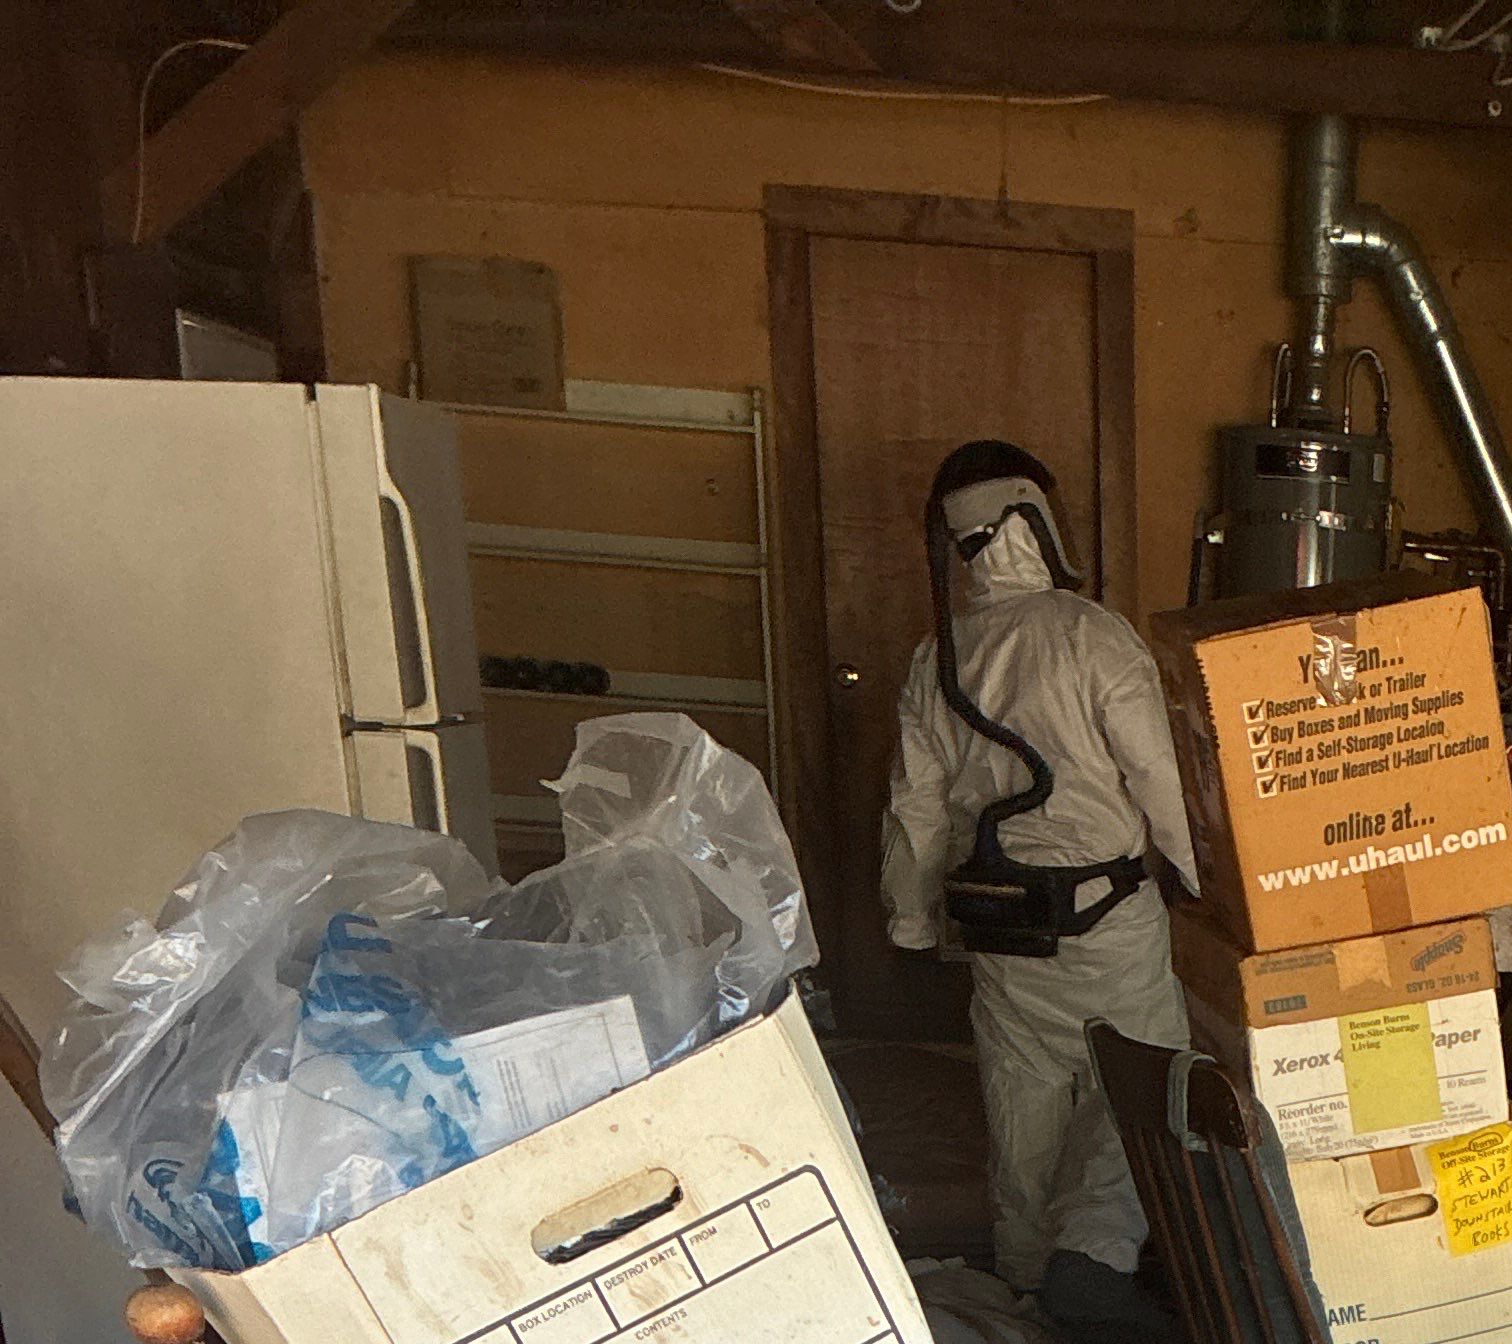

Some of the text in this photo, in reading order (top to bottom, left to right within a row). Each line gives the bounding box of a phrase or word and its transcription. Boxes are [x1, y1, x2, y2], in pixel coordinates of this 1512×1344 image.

[1266, 696, 1317, 720] Reserve
[1369, 681, 1382, 698] or
[1386, 671, 1427, 693] Trailer
[1271, 689, 1464, 745] Buy Boxes and Moving Supplies
[1275, 729, 1393, 769] Find a Self-Storage
[1279, 771, 1306, 793] Find
[1310, 764, 1338, 787] Your
[1343, 754, 1390, 781] Nearest
[1437, 734, 1489, 760] Location
[1324, 801, 1435, 846] online at...
[1257, 821, 1507, 892] www.uhaul.com
[1411, 932, 1466, 972] Snapple
[1406, 978, 1436, 993] GLASS
[1351, 1039, 1381, 1053] Living
[1386, 1022, 1421, 1037] Storage
[1272, 1053, 1332, 1077] Xerox
[1277, 1100, 1348, 1121] Reorder no.
[755, 1198, 772, 1213] TO
[1451, 1176, 1511, 1213] STEWART
[688, 1225, 718, 1247] FROM
[604, 1246, 678, 1291] DESTROY DATE
[518, 1289, 593, 1334] BOX LOCATION
[635, 1307, 689, 1341] CONTENTS
[1327, 1303, 1368, 1327] AME
